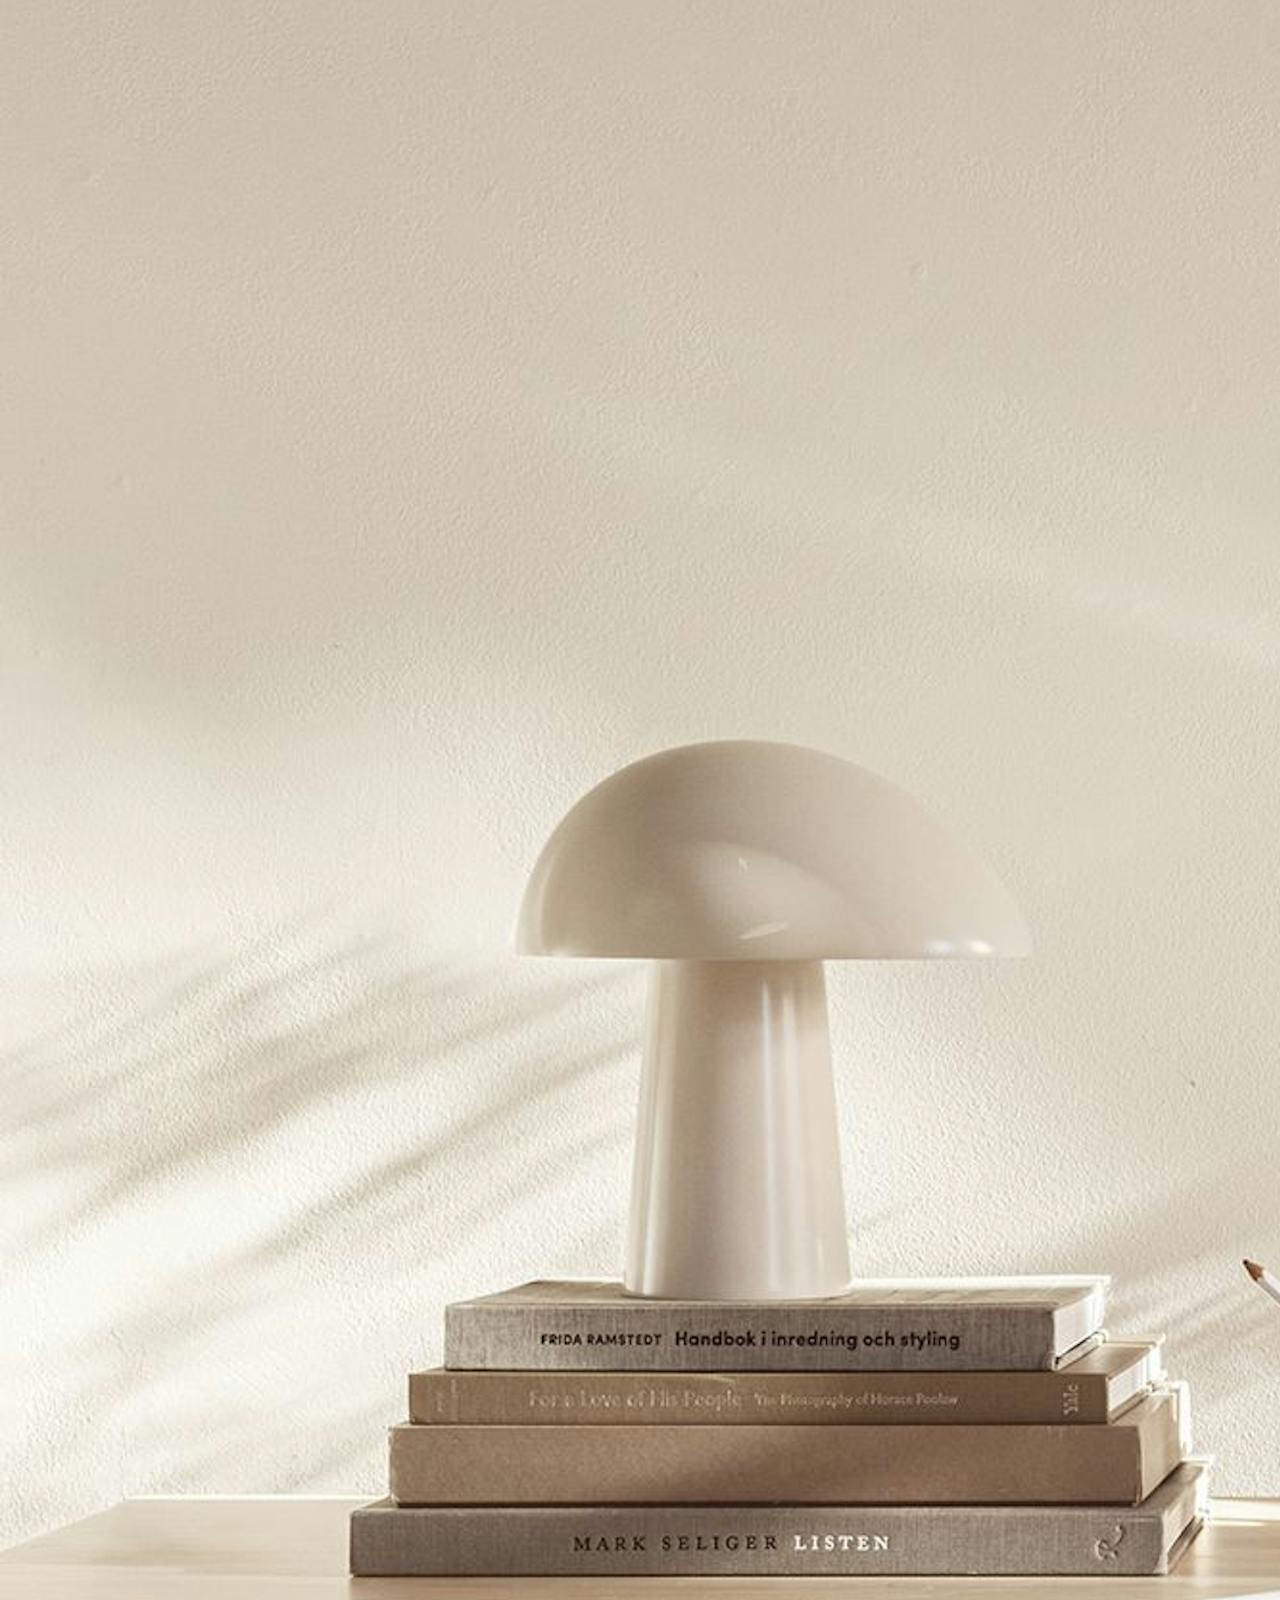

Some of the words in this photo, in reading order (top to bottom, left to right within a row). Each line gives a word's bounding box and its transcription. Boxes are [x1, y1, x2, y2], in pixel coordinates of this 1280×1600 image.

[541, 1334, 582, 1346] FRIDA
[587, 1334, 662, 1346] RAMSTEDT
[675, 1331, 756, 1347] Handbok
[761, 1330, 767, 1347] i
[771, 1330, 858, 1351] inredning
[863, 1330, 895, 1347] och
[901, 1330, 961, 1351] styling
[581, 1389, 621, 1407] Love
[626, 1389, 645, 1407] of
[684, 1389, 743, 1412] People
[573, 1536, 646, 1551] MARK
[661, 1536, 777, 1551] SELIGER
[794, 1535, 889, 1551] LISTEN
